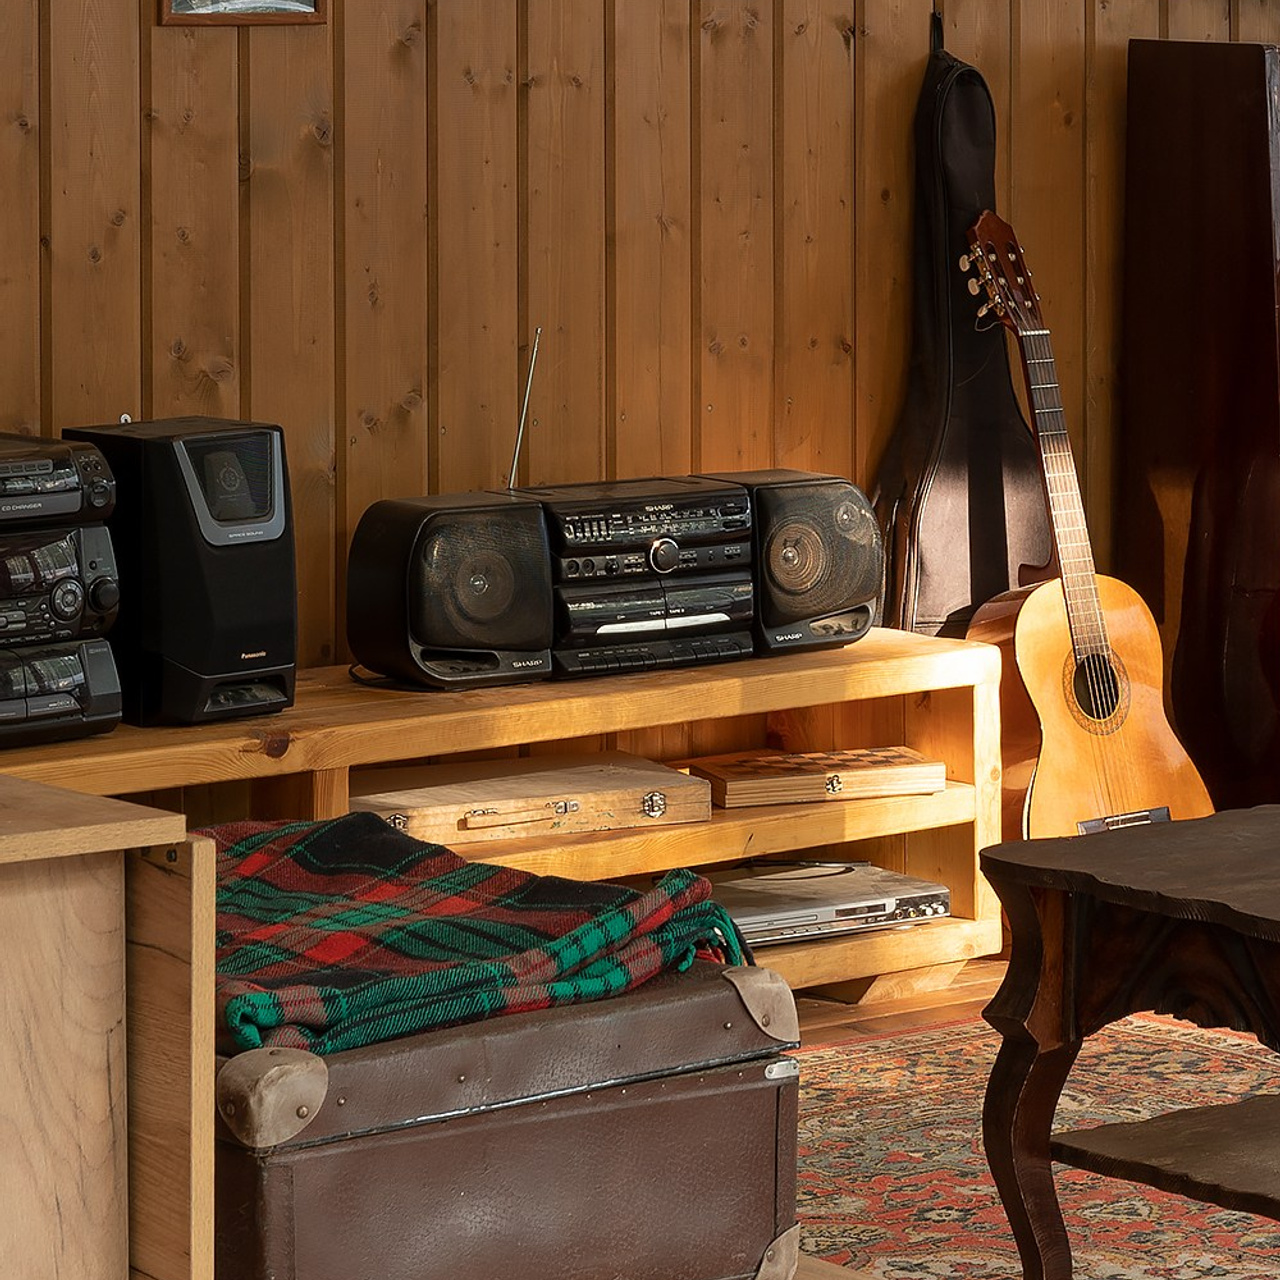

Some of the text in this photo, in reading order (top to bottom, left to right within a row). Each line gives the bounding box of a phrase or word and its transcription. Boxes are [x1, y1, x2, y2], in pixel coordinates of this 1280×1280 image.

[645, 504, 674, 512] SHARP
[775, 633, 803, 642] SHARP
[512, 660, 543, 668] SHARP
